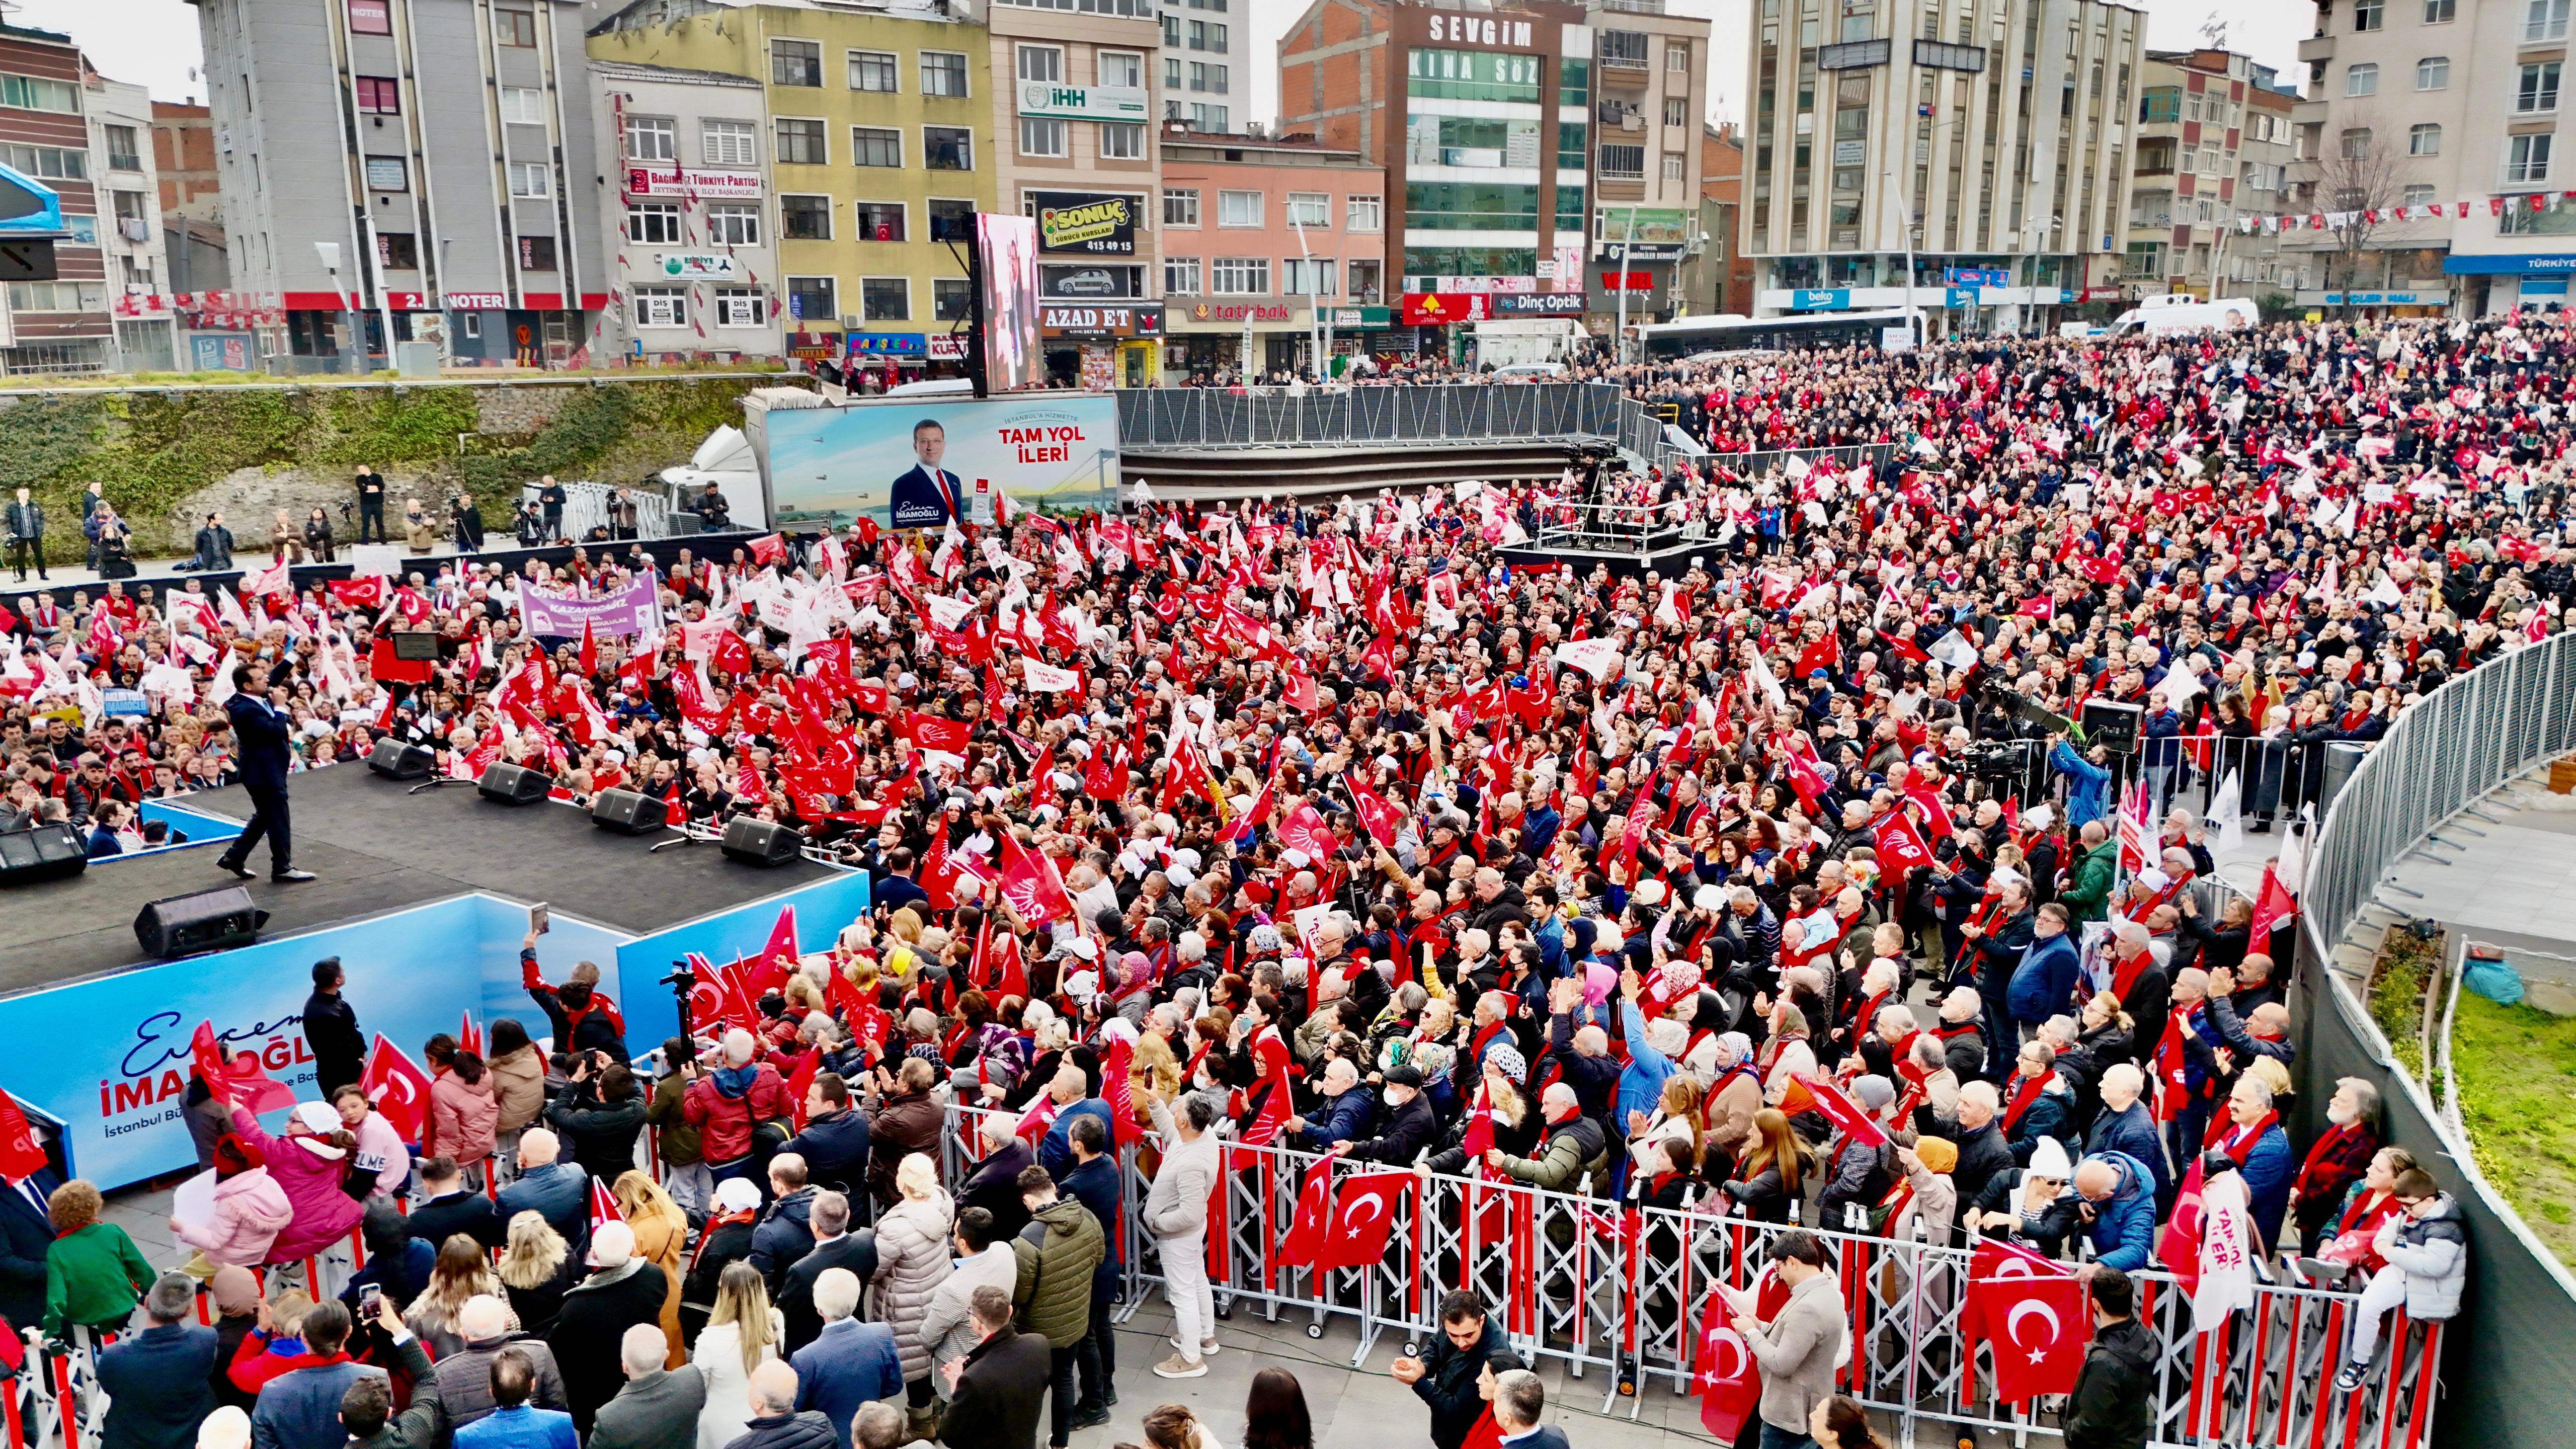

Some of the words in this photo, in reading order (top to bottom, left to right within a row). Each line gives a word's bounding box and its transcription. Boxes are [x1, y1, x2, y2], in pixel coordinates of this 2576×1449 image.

[351, 8, 385, 18] NOTER
[1430, 15, 1531, 47] SEVGİM
[1409, 51, 1472, 79] KINA
[1495, 58, 1537, 84] SÖZ
[692, 174, 726, 186] TÜRKİYE
[727, 175, 759, 188] PARTİSİ
[1057, 201, 1126, 229] SONUÇ
[1056, 232, 1080, 243] SÜRÜCÜ
[1081, 227, 1112, 238] KURSLARI
[1087, 241, 1104, 251] 415
[1106, 241, 1118, 251] 49
[1120, 242, 1132, 251] 15
[1629, 252, 1656, 260] ARDİNLİLER
[2528, 258, 2576, 268] TÜRKİYE
[406, 294, 423, 308] 2.
[1518, 295, 1544, 311] Dinç
[1546, 294, 1580, 311] Optik
[1808, 291, 1833, 301] beko
[2325, 294, 2382, 304] GEÇLER
[654, 299, 668, 308] DİŞ
[734, 299, 747, 308] DİŞ
[1044, 309, 1097, 327] AZAD
[1102, 309, 1129, 327] ET
[201, 339, 215, 353] 15
[226, 339, 243, 353] 45
[1004, 413, 1043, 424] İSTANBUL'A
[1045, 411, 1078, 422] HİZMETTE
[998, 428, 1042, 444] TAM
[1046, 426, 1086, 442] YOL
[1017, 441, 1069, 463] İLERİ
[896, 509, 939, 519] İMAMOĞLU
[549, 599, 628, 613] KAZANACAĞIZ
[770, 600, 782, 610] TAM
[1033, 669, 1051, 678] TAM
[1051, 672, 1065, 681] YOL
[1040, 677, 1060, 685] İLERİ
[104, 1112, 162, 1139] İstanbul
